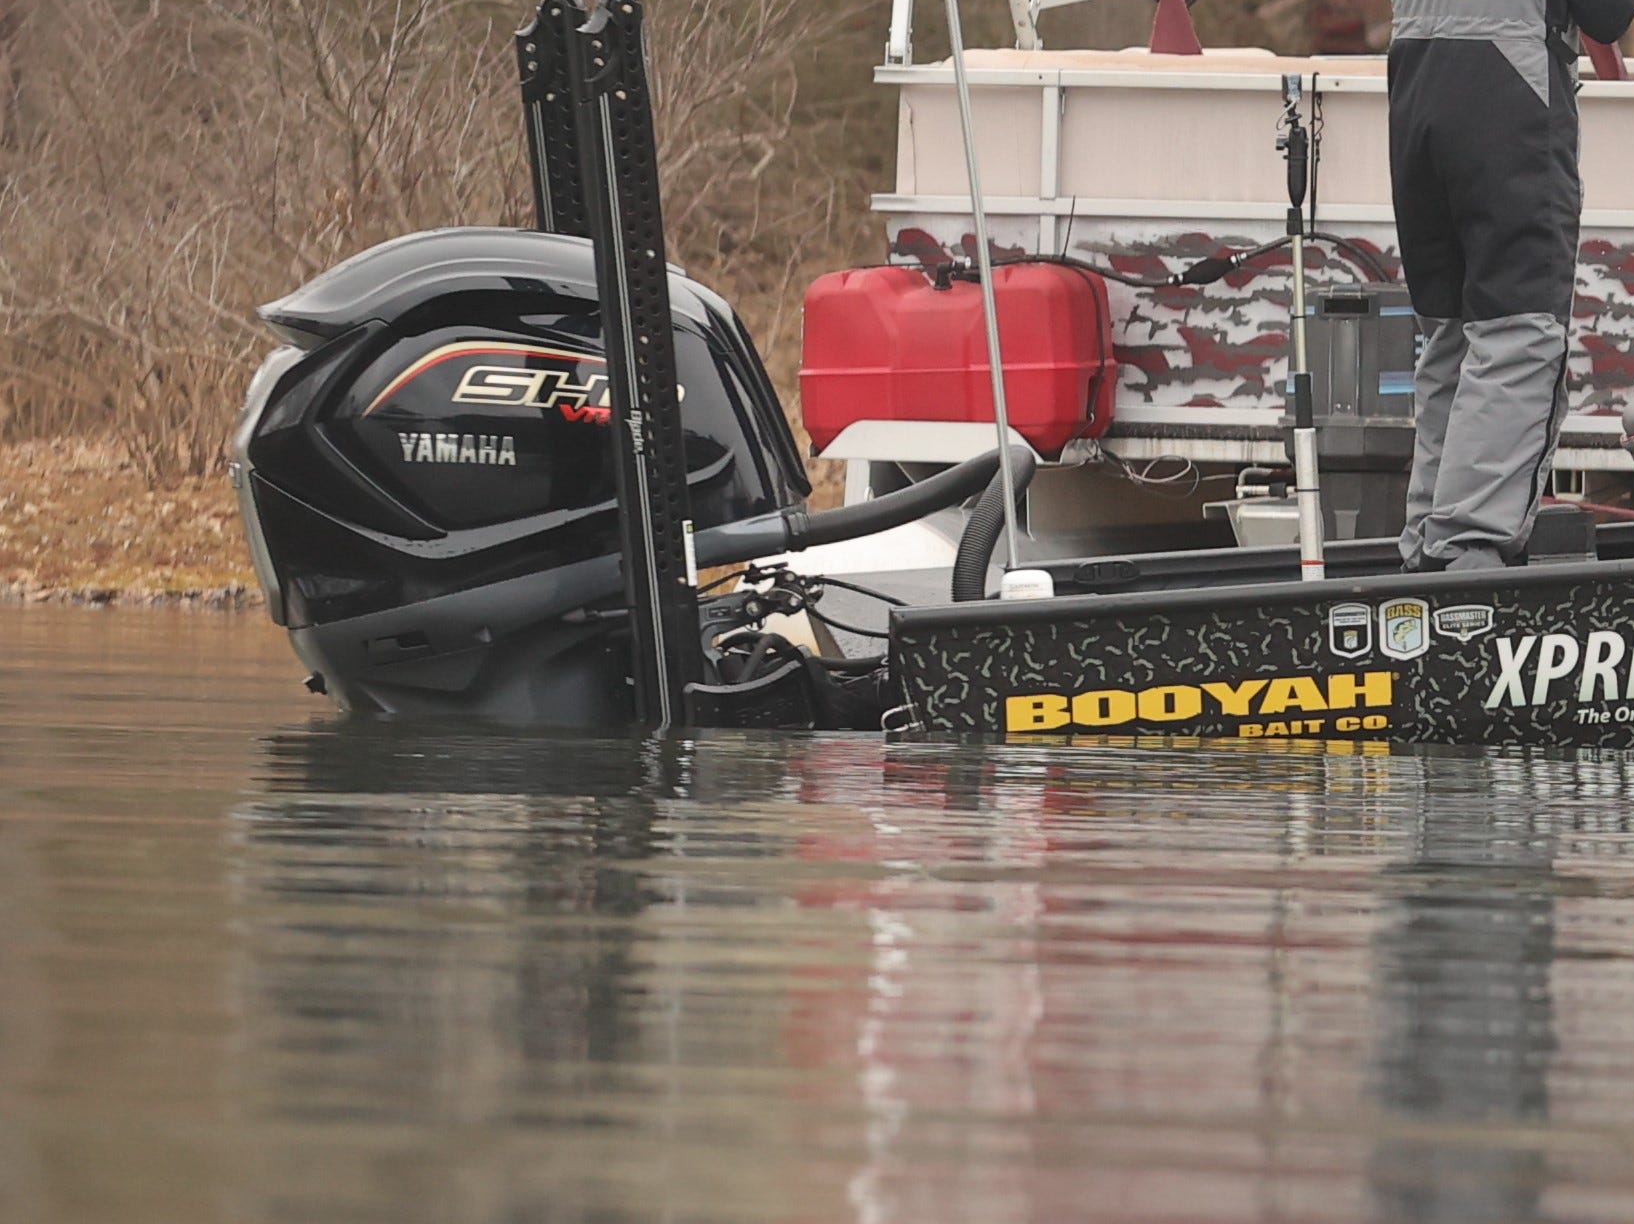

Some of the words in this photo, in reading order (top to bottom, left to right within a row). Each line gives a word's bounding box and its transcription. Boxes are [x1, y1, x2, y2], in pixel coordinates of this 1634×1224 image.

[398, 433, 517, 466] YAMAHA
[1387, 605, 1422, 619] BASS
[1005, 671, 1393, 733] BOOYAH
[1238, 719, 1324, 738] BAIT
[1336, 714, 1393, 732] CO.
[1577, 708, 1611, 724] The
